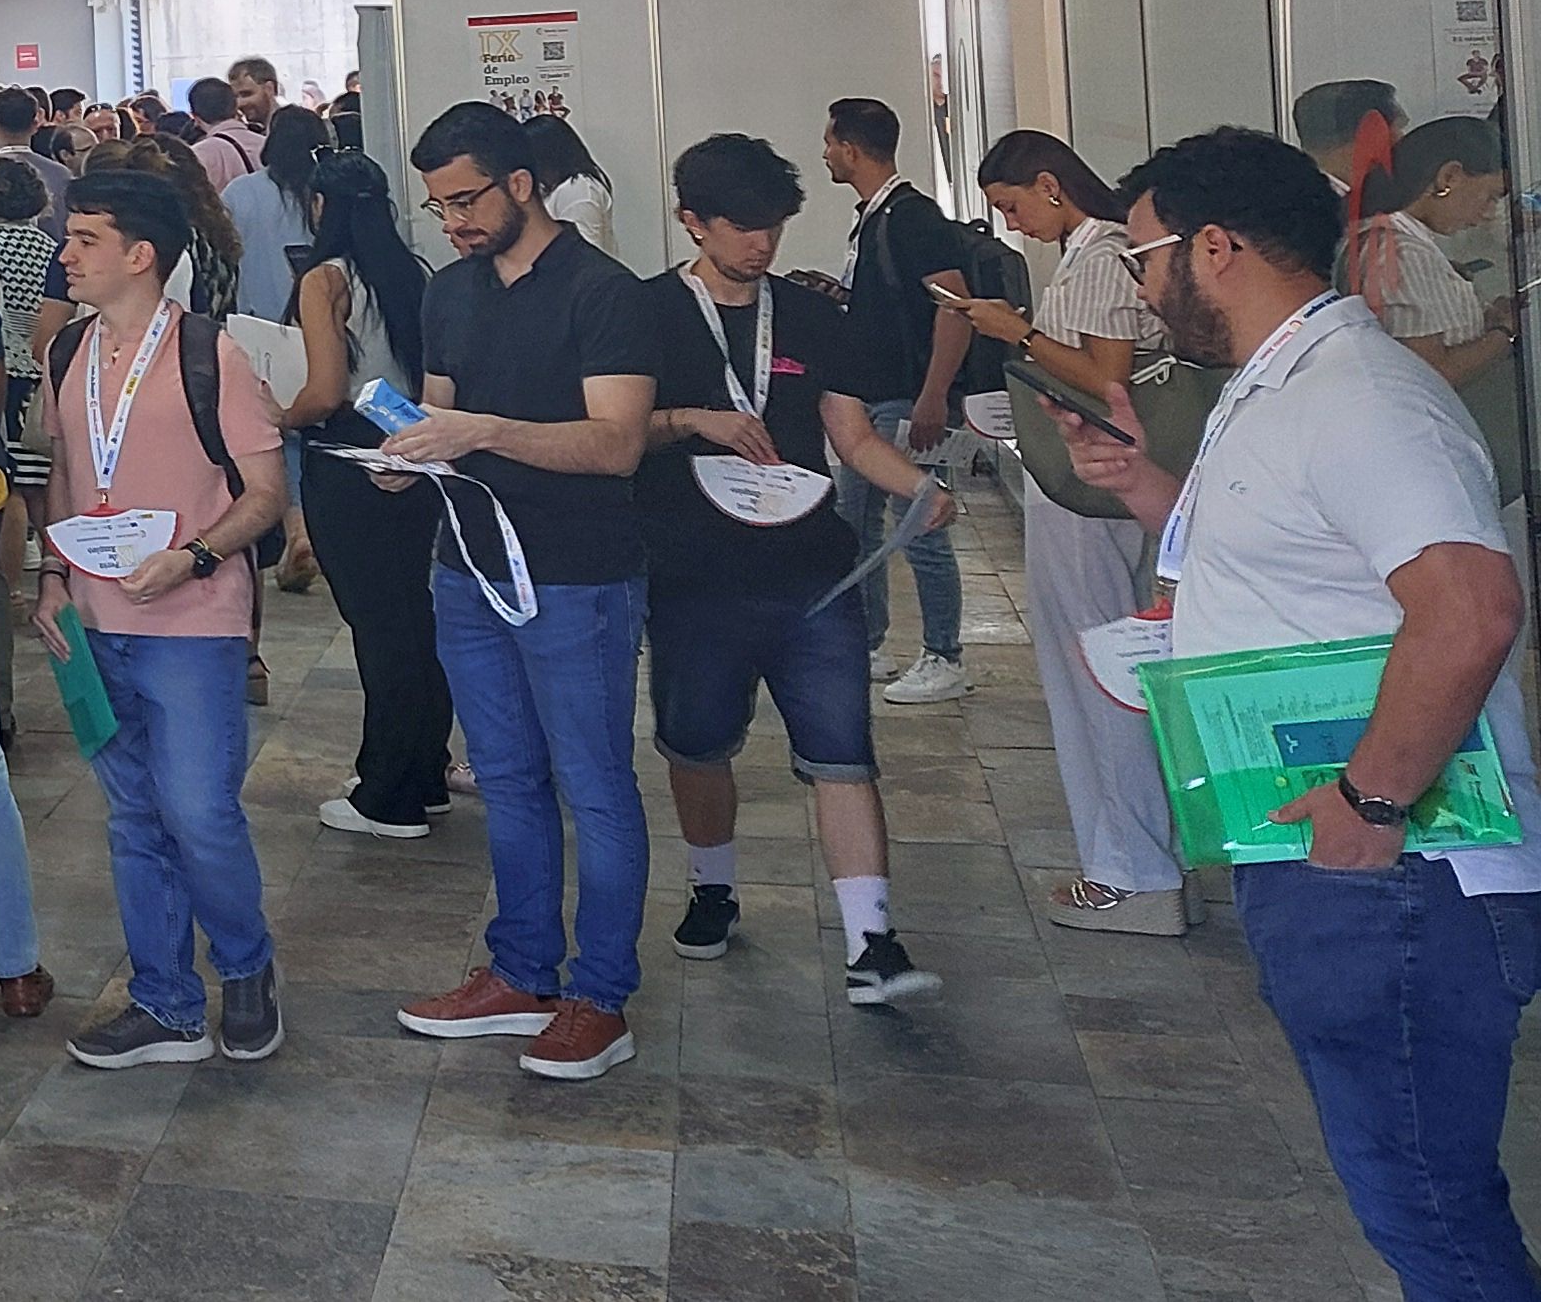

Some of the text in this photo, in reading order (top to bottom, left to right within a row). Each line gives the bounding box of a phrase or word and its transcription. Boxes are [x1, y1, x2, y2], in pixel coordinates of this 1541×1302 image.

[483, 54, 515, 63] Feria
[484, 65, 498, 74] de
[484, 75, 529, 86] Empleo
